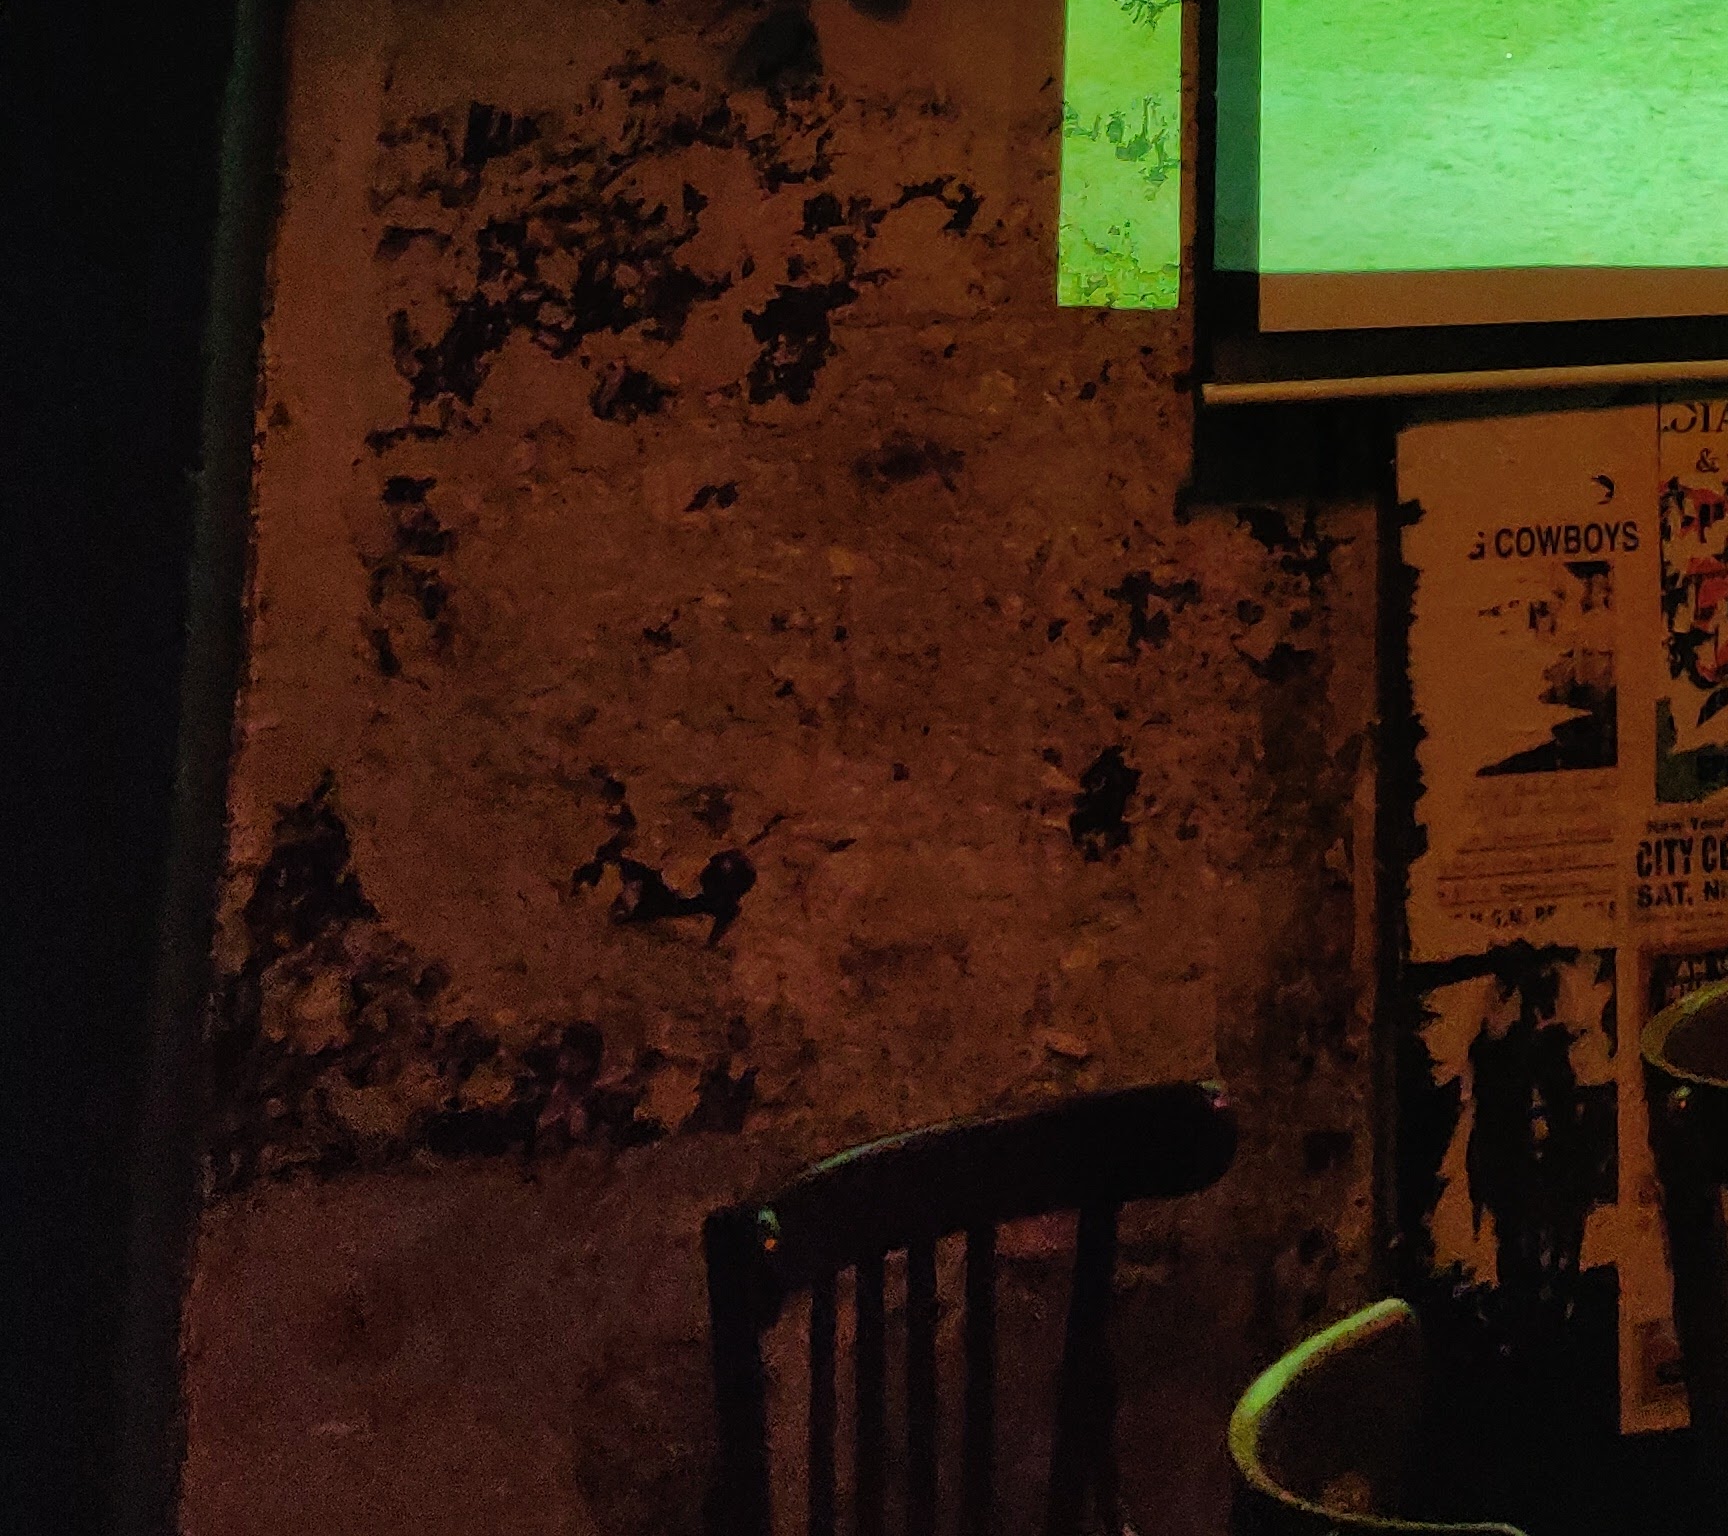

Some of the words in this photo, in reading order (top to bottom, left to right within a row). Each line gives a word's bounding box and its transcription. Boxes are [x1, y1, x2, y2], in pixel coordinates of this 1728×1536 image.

[1695, 447, 1719, 473] &
[1494, 521, 1639, 558] COWBOYS
[1636, 836, 1694, 878] CITY
